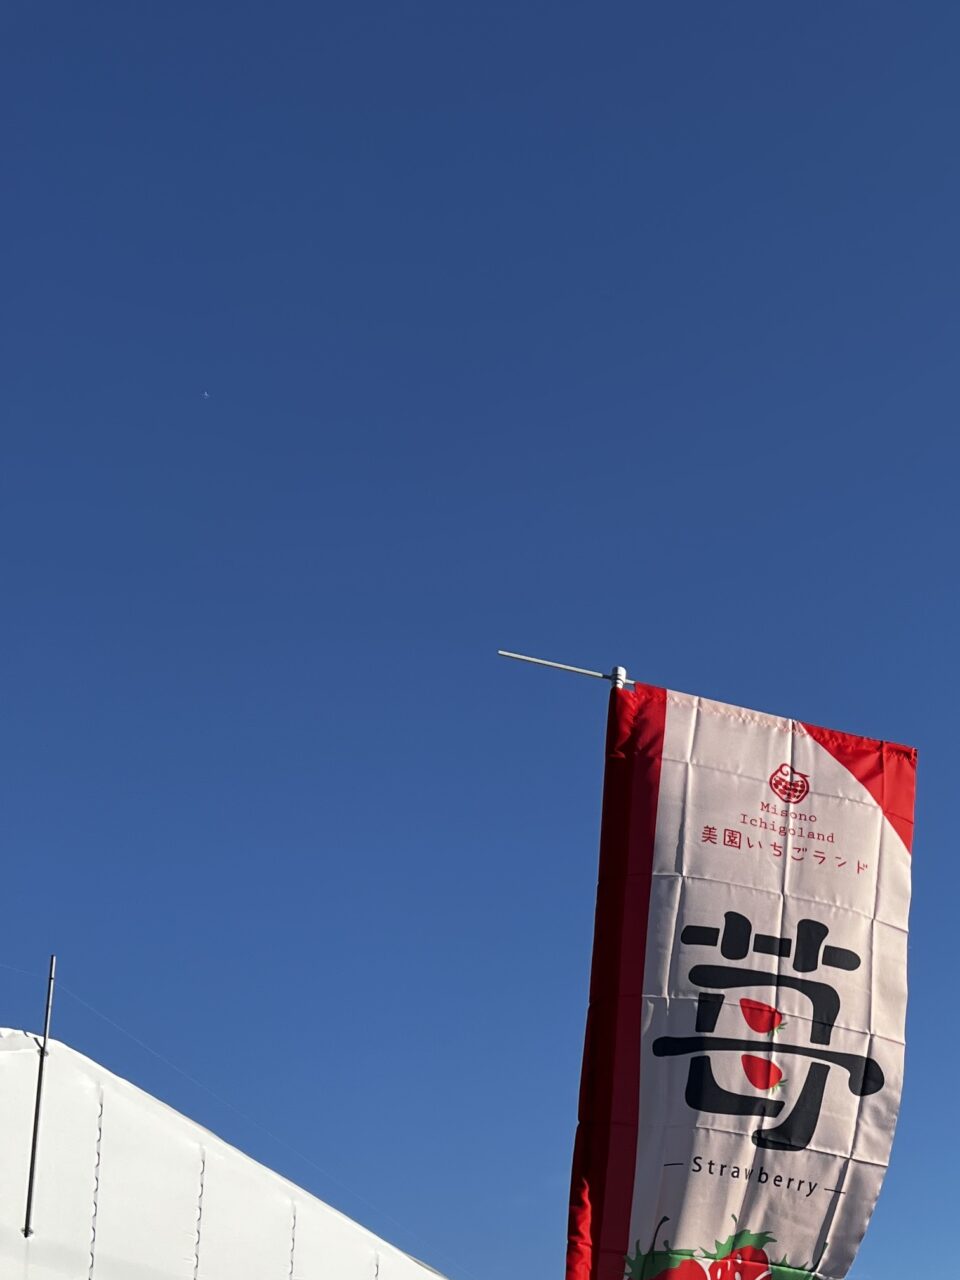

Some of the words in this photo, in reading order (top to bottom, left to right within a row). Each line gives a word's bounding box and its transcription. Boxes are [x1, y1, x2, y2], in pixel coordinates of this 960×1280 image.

[739, 813, 836, 844] Ichigoland
[760, 802, 818, 823] Misono
[701, 825, 868, 874] 美園いちごランド
[652, 911, 885, 1152] 苺
[692, 1156, 818, 1198] Strawberry
